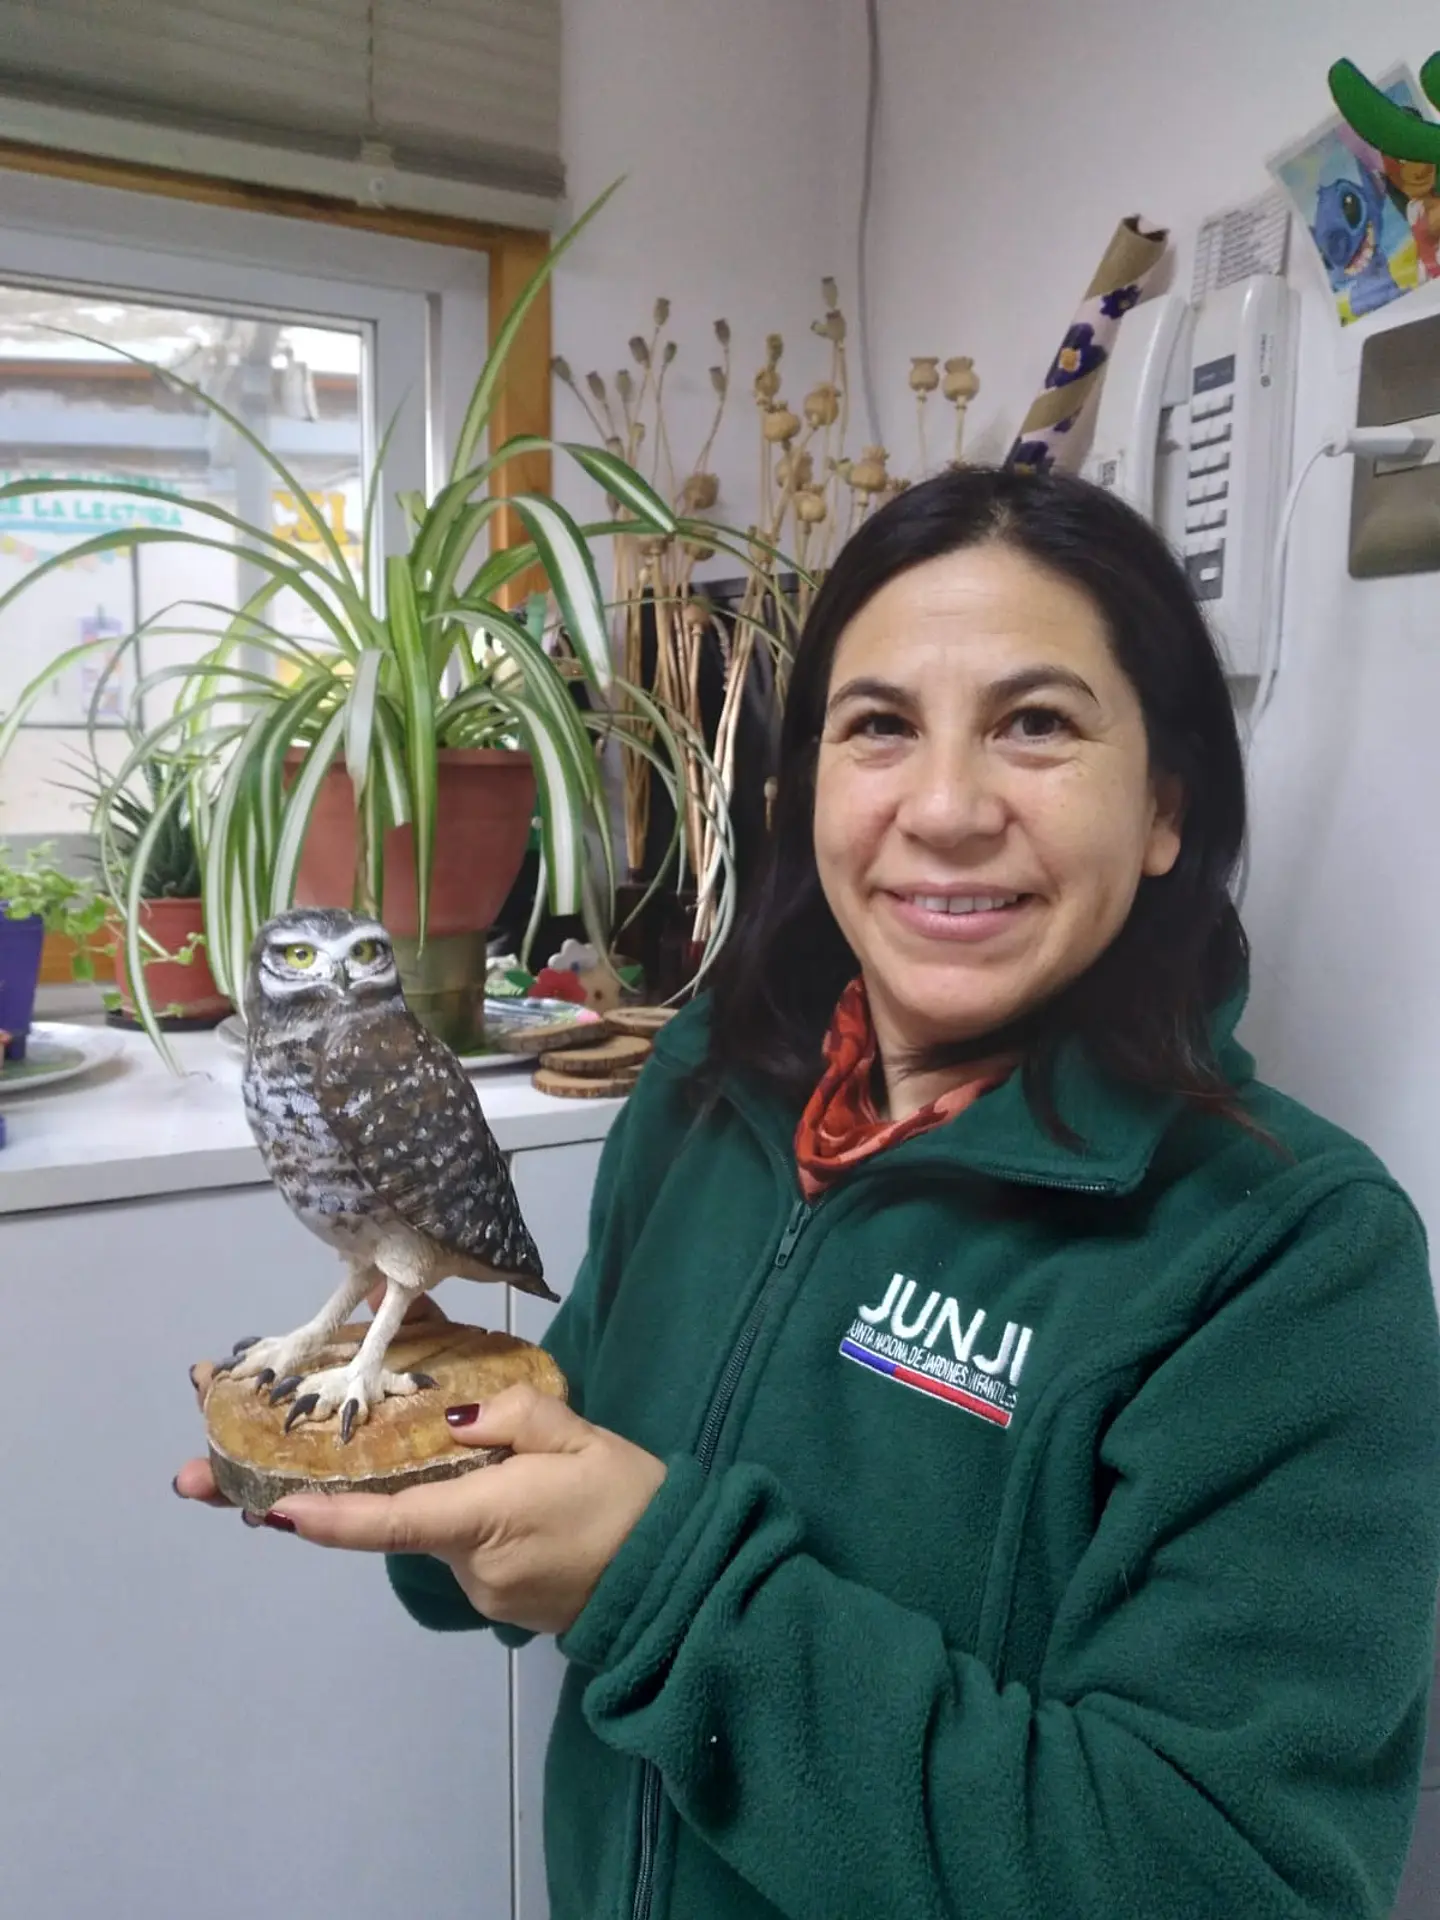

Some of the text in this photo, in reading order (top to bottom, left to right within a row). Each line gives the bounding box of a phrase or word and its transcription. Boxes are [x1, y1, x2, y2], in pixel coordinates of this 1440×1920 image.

[34, 497, 65, 518] LA
[858, 1273, 1033, 1386] JUNJI
[906, 1345, 927, 1368] DE
[921, 1352, 969, 1387] JARDINES
